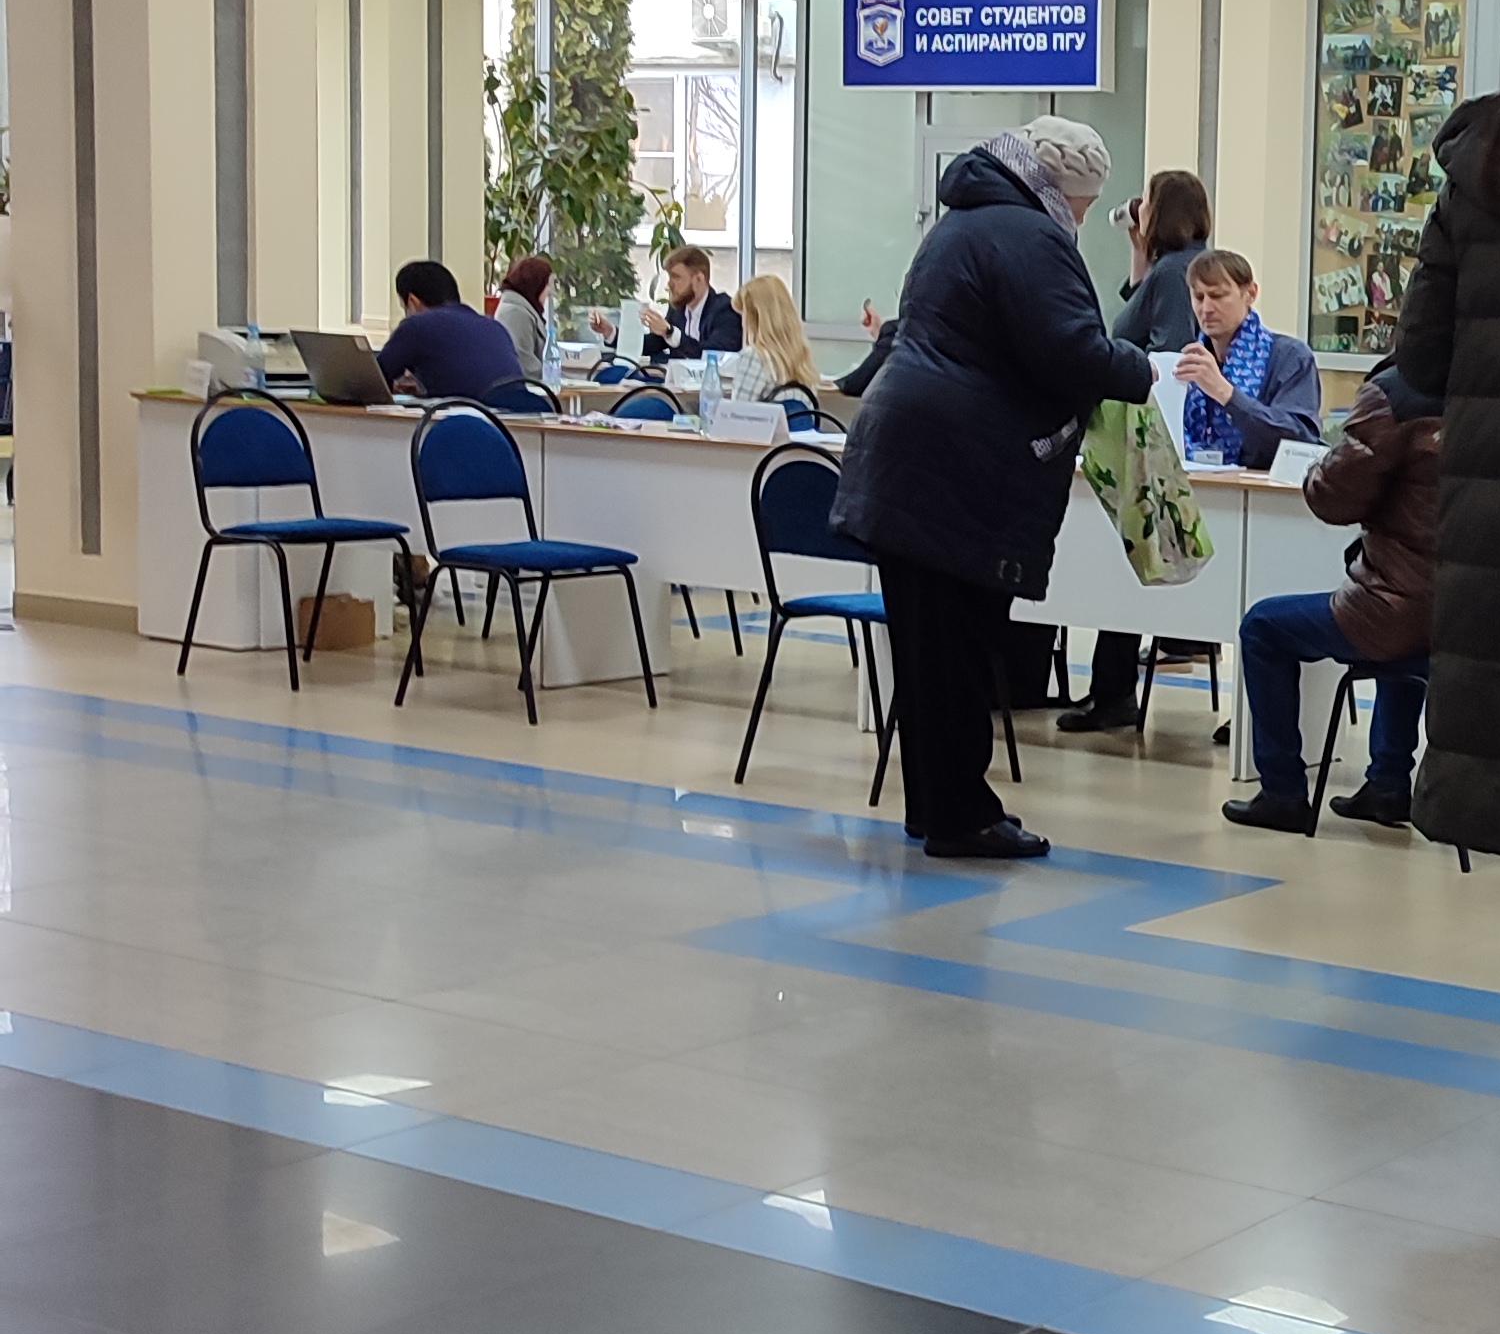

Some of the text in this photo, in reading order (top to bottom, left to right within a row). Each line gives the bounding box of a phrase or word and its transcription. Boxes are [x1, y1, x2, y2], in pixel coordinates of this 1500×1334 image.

[915, 5, 1087, 29] СОВЕТ СТУДЕНТОВ
[915, 31, 1087, 53] И АСПИРАНТОВ ПГУ
